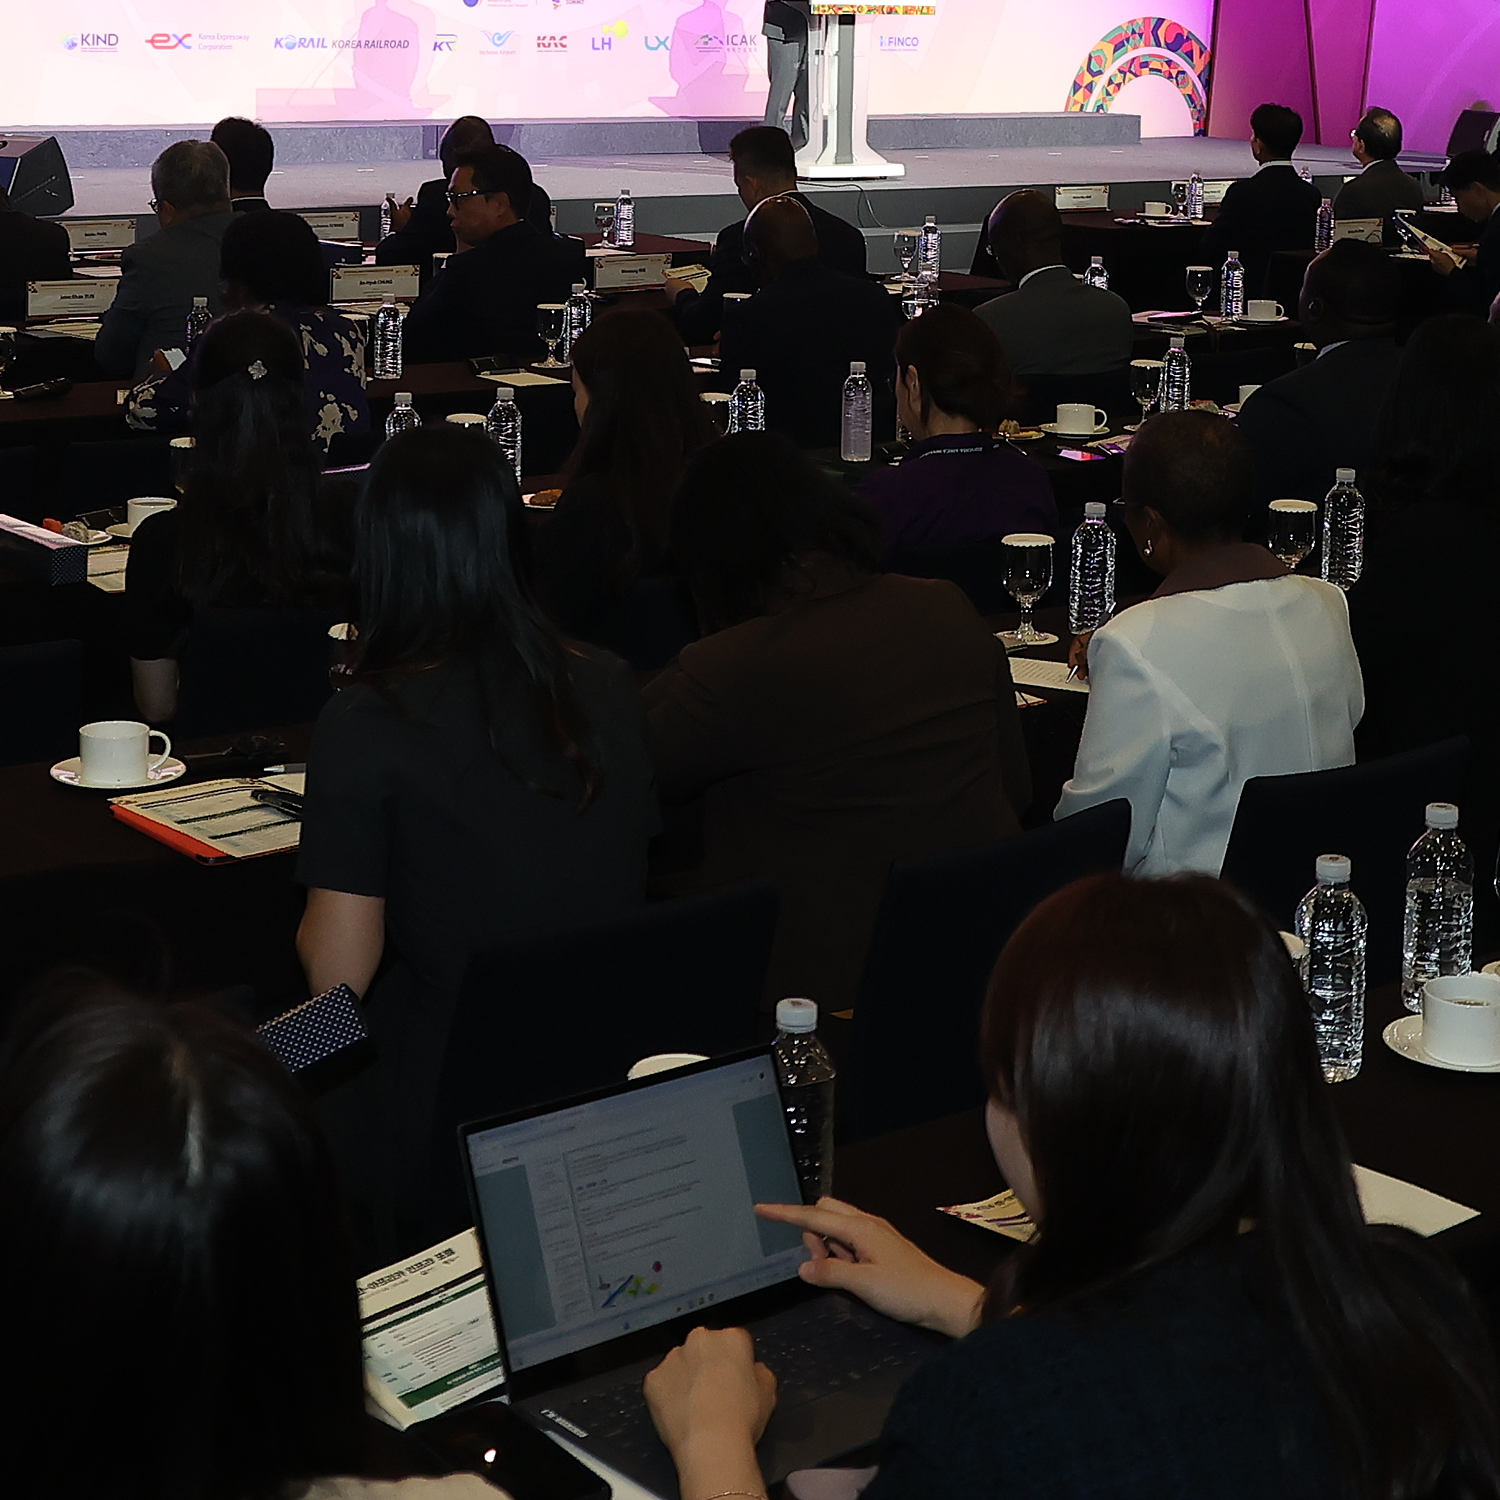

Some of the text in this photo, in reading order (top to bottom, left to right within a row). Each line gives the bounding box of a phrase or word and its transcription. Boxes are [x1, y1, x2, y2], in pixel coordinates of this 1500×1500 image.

[81, 33, 119, 46] KIND
[216, 33, 250, 42] Expressway
[331, 39, 362, 49] KOREA
[364, 39, 410, 49] RAILROAD
[537, 35, 567, 48] KAC
[592, 37, 611, 50] LH
[644, 36, 670, 50] LX
[727, 34, 757, 46] ICAK
